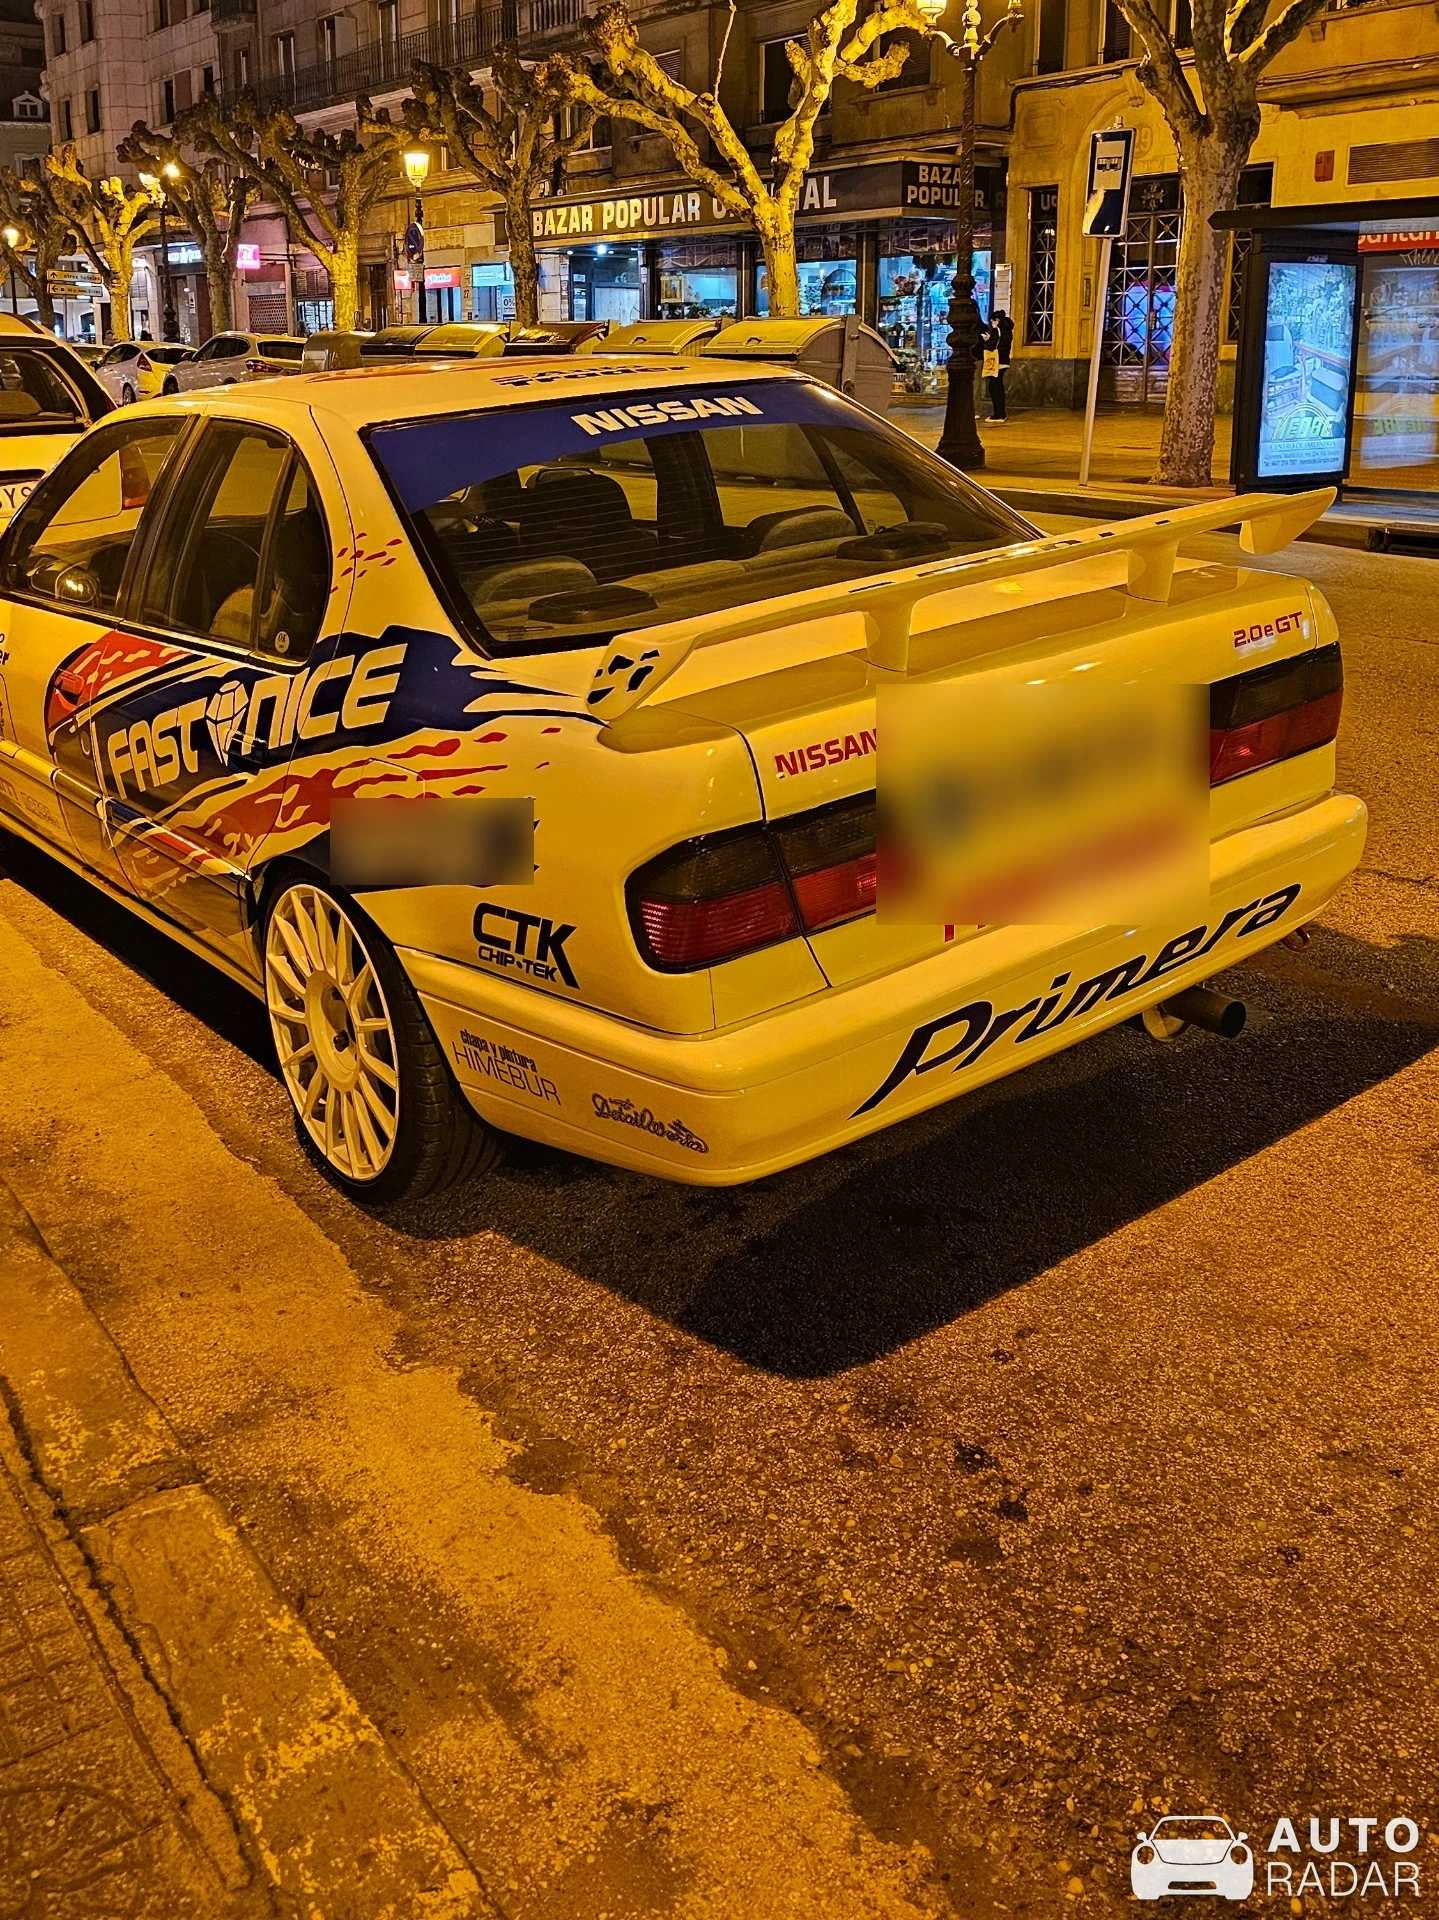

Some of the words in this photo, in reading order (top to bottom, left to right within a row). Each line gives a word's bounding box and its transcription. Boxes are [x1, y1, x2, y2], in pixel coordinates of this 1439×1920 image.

[907, 185, 984, 206] POPULR
[919, 165, 960, 184] BAZA
[532, 204, 593, 237] BAZAR
[602, 192, 700, 230] POPULAR
[571, 396, 763, 435] NISSAN
[107, 697, 207, 799] FAST
[775, 728, 876, 779] NISSAN
[472, 902, 580, 990] CTK
[846, 883, 1302, 1120] Primera
[451, 1041, 561, 1106] HIMEBUR
[460, 1028, 489, 1053] chapa
[489, 1041, 499, 1057] y
[498, 1045, 537, 1073] pintura
